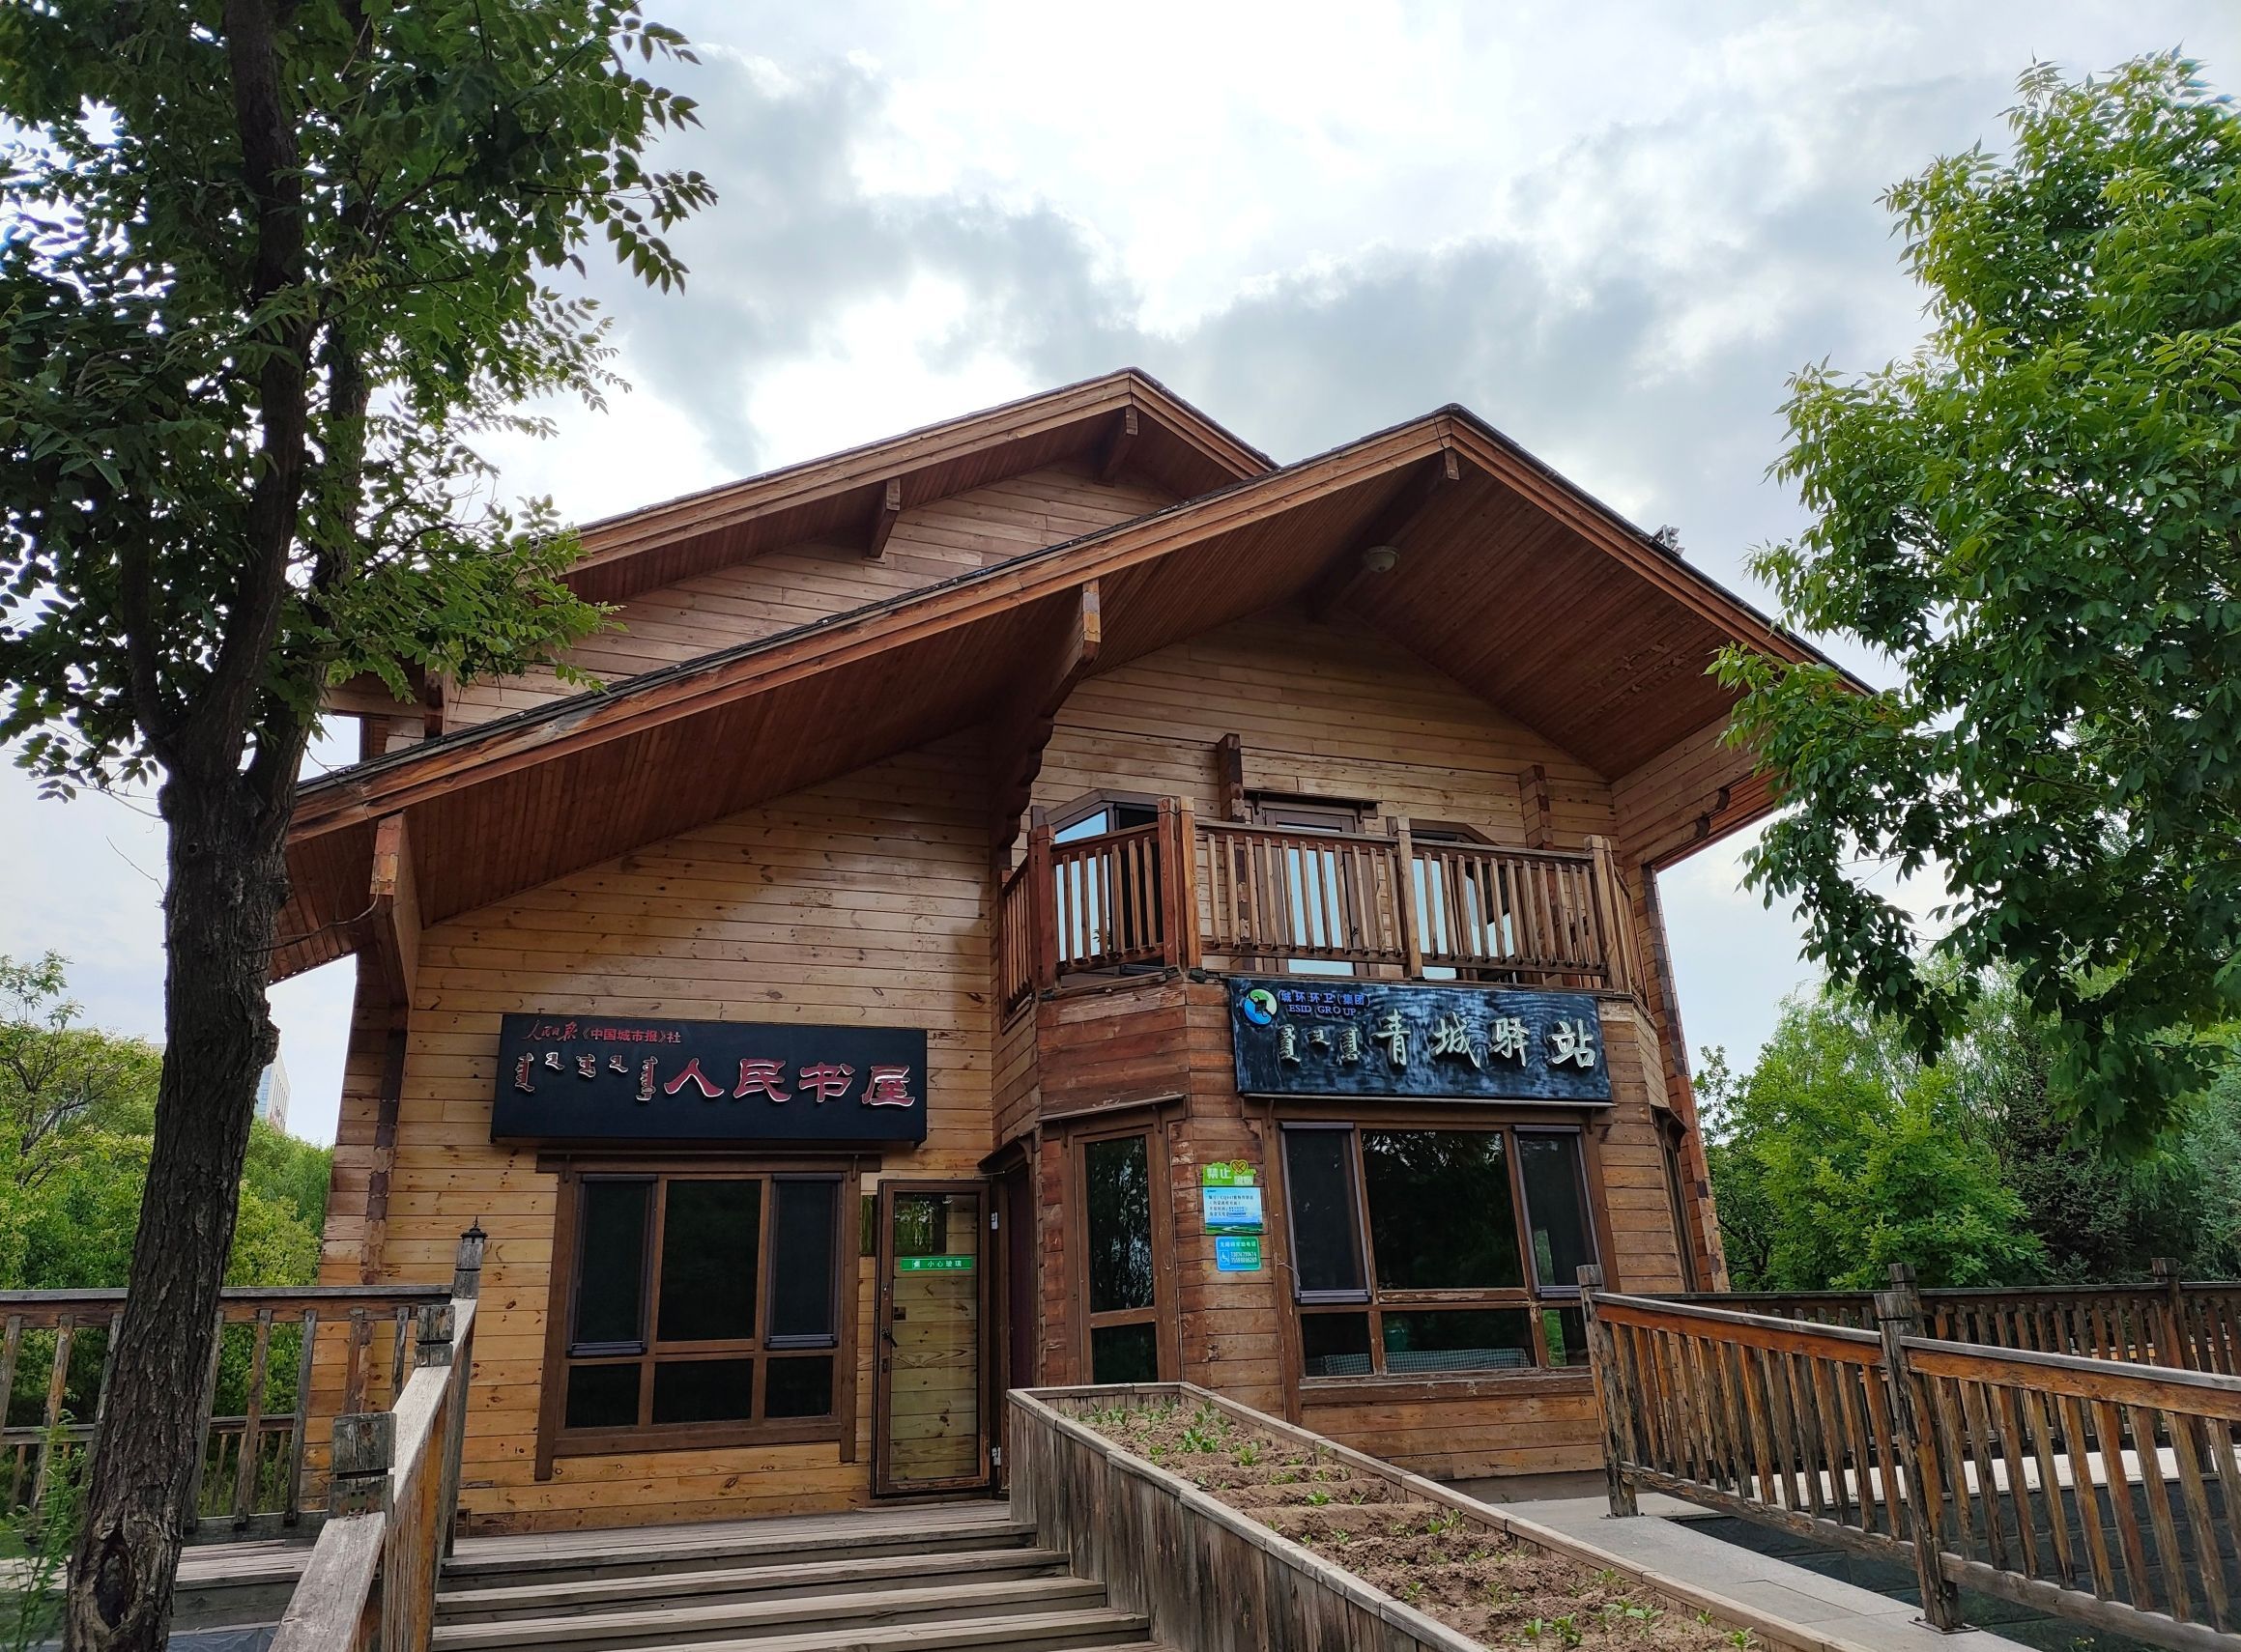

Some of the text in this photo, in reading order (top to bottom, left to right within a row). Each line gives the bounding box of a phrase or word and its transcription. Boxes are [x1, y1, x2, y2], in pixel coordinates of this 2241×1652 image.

[1288, 1005, 1356, 1016] ESID GROUP
[1371, 1009, 1595, 1068] 青城驿站
[664, 1058, 915, 1106] 人民书屋
[927, 1260, 962, 1268] 小心玻璃
